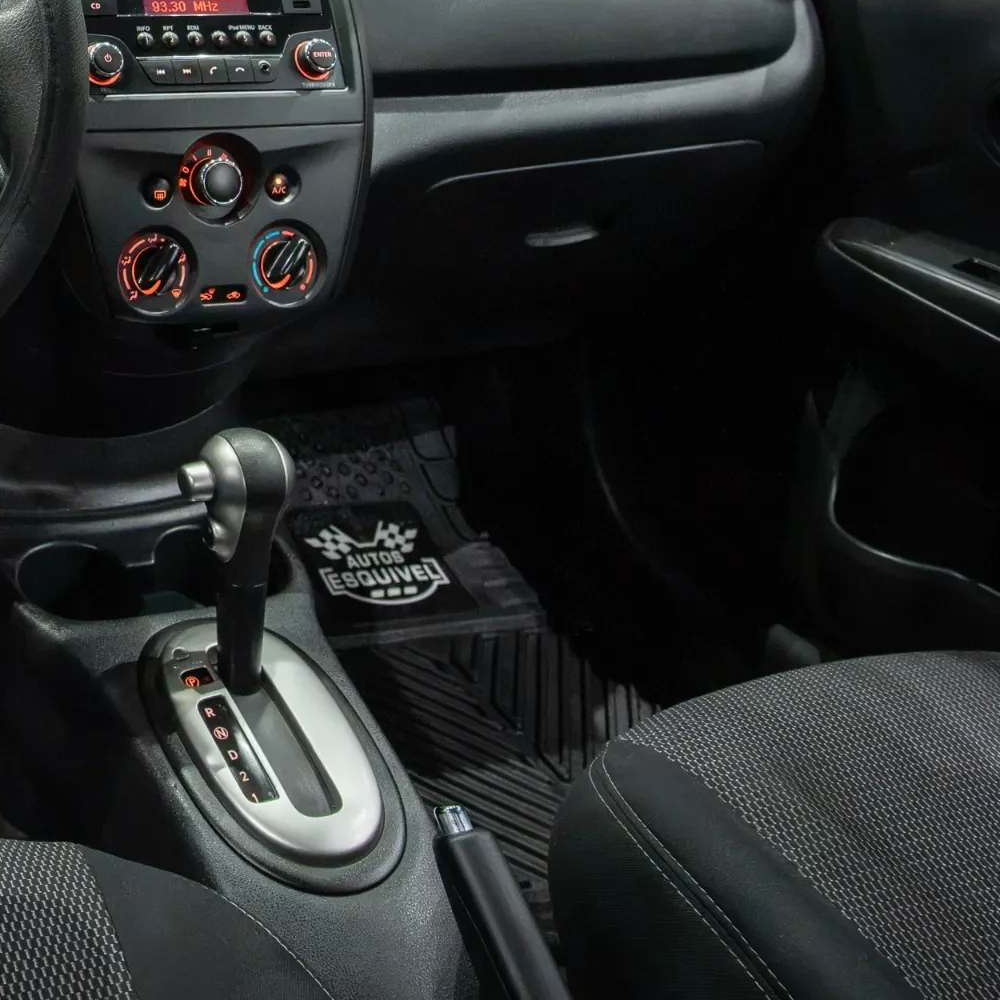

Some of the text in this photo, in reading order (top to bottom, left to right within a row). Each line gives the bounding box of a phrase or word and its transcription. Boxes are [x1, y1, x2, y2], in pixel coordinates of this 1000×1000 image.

[152, 1, 219, 13] 93.30 MHz
[272, 186, 286, 194] A/C
[346, 551, 405, 569] AUTOS
[327, 563, 441, 590] ESQUIVEL
[204, 707, 216, 718] R
[228, 750, 239, 760] D
[239, 771, 249, 782] 2
[252, 793, 259, 803] 1
